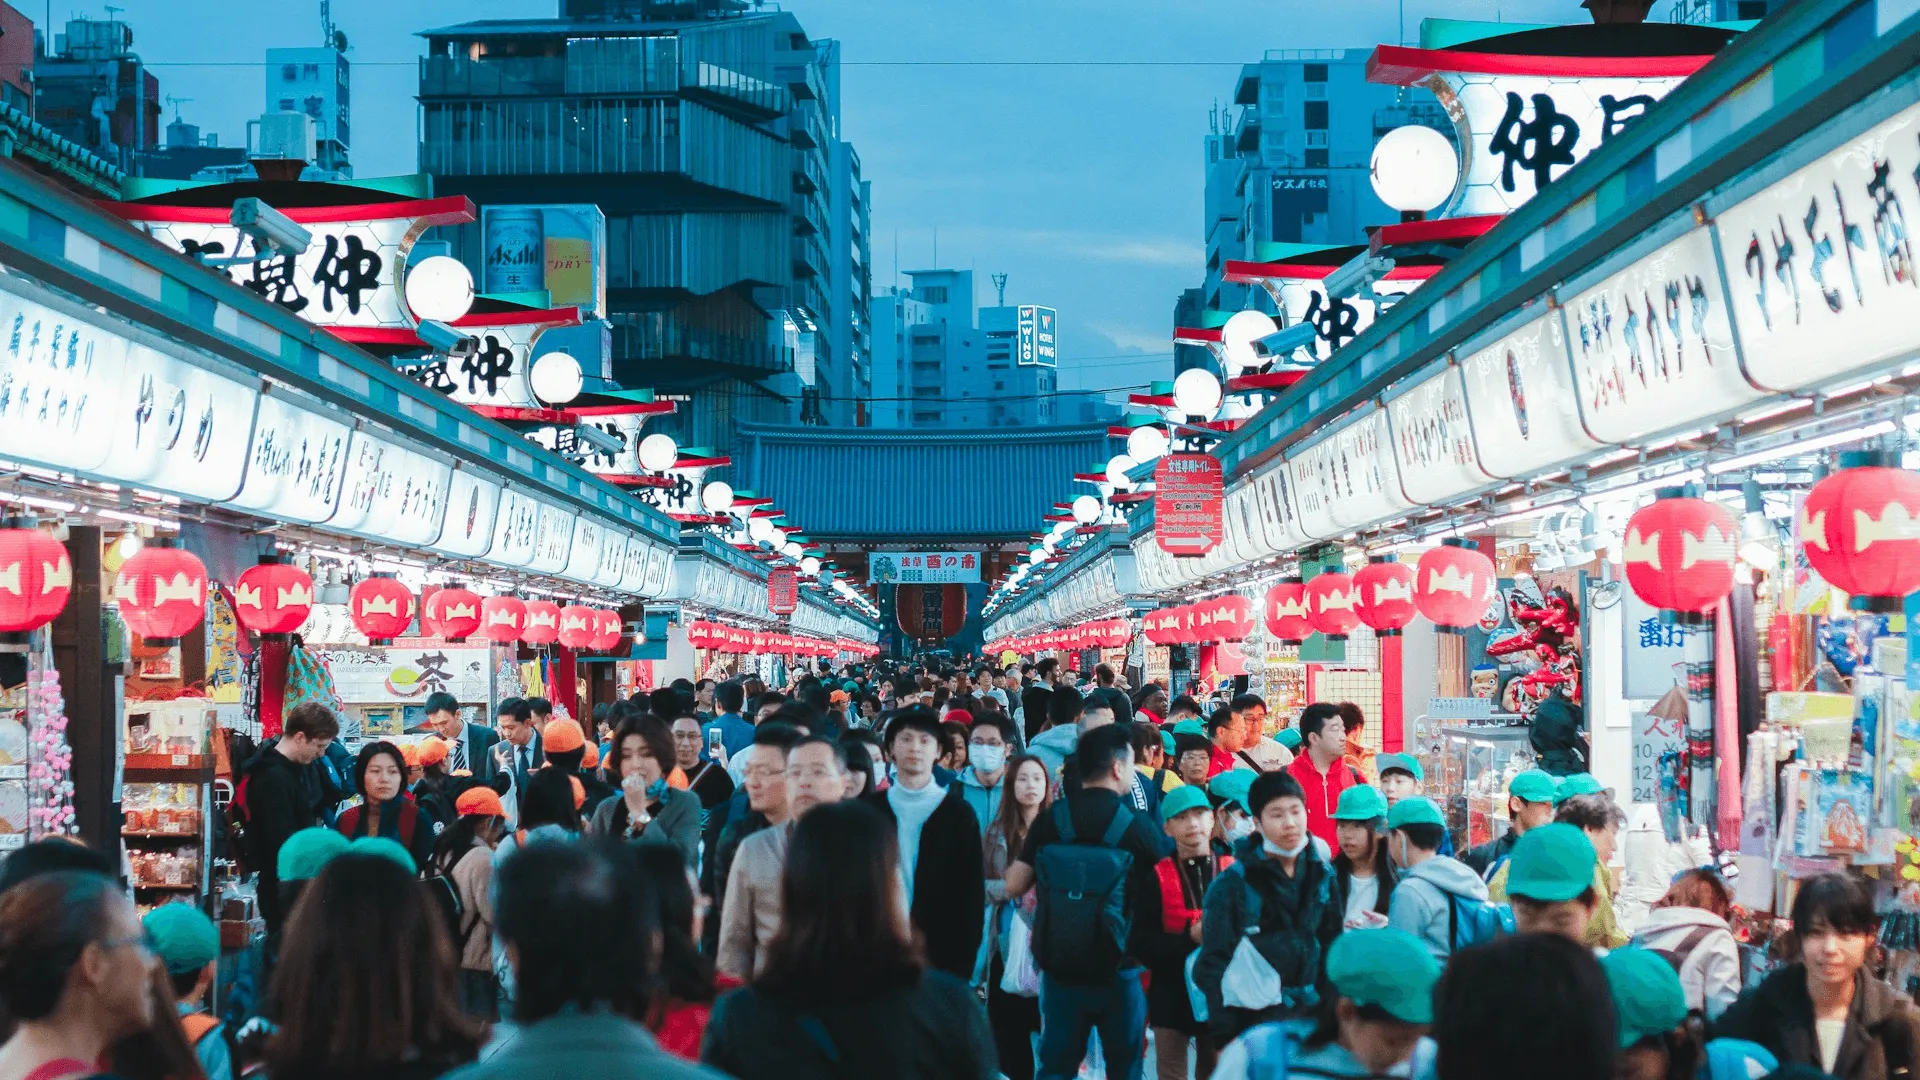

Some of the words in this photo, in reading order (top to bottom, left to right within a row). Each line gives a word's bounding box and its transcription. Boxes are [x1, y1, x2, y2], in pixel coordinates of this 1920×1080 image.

[488, 242, 540, 266] Asahi
[507, 274, 521, 285] 生
[1021, 327, 1032, 360] WING
[1039, 333, 1053, 344] HOTEL
[1038, 345, 1055, 358] WING
[1168, 460, 1210, 473] 女性専用トイレ
[414, 650, 455, 694] 茶
[1633, 743, 1652, 758] 10
[1633, 766, 1652, 780] 12
[1633, 787, 1652, 802] 24
